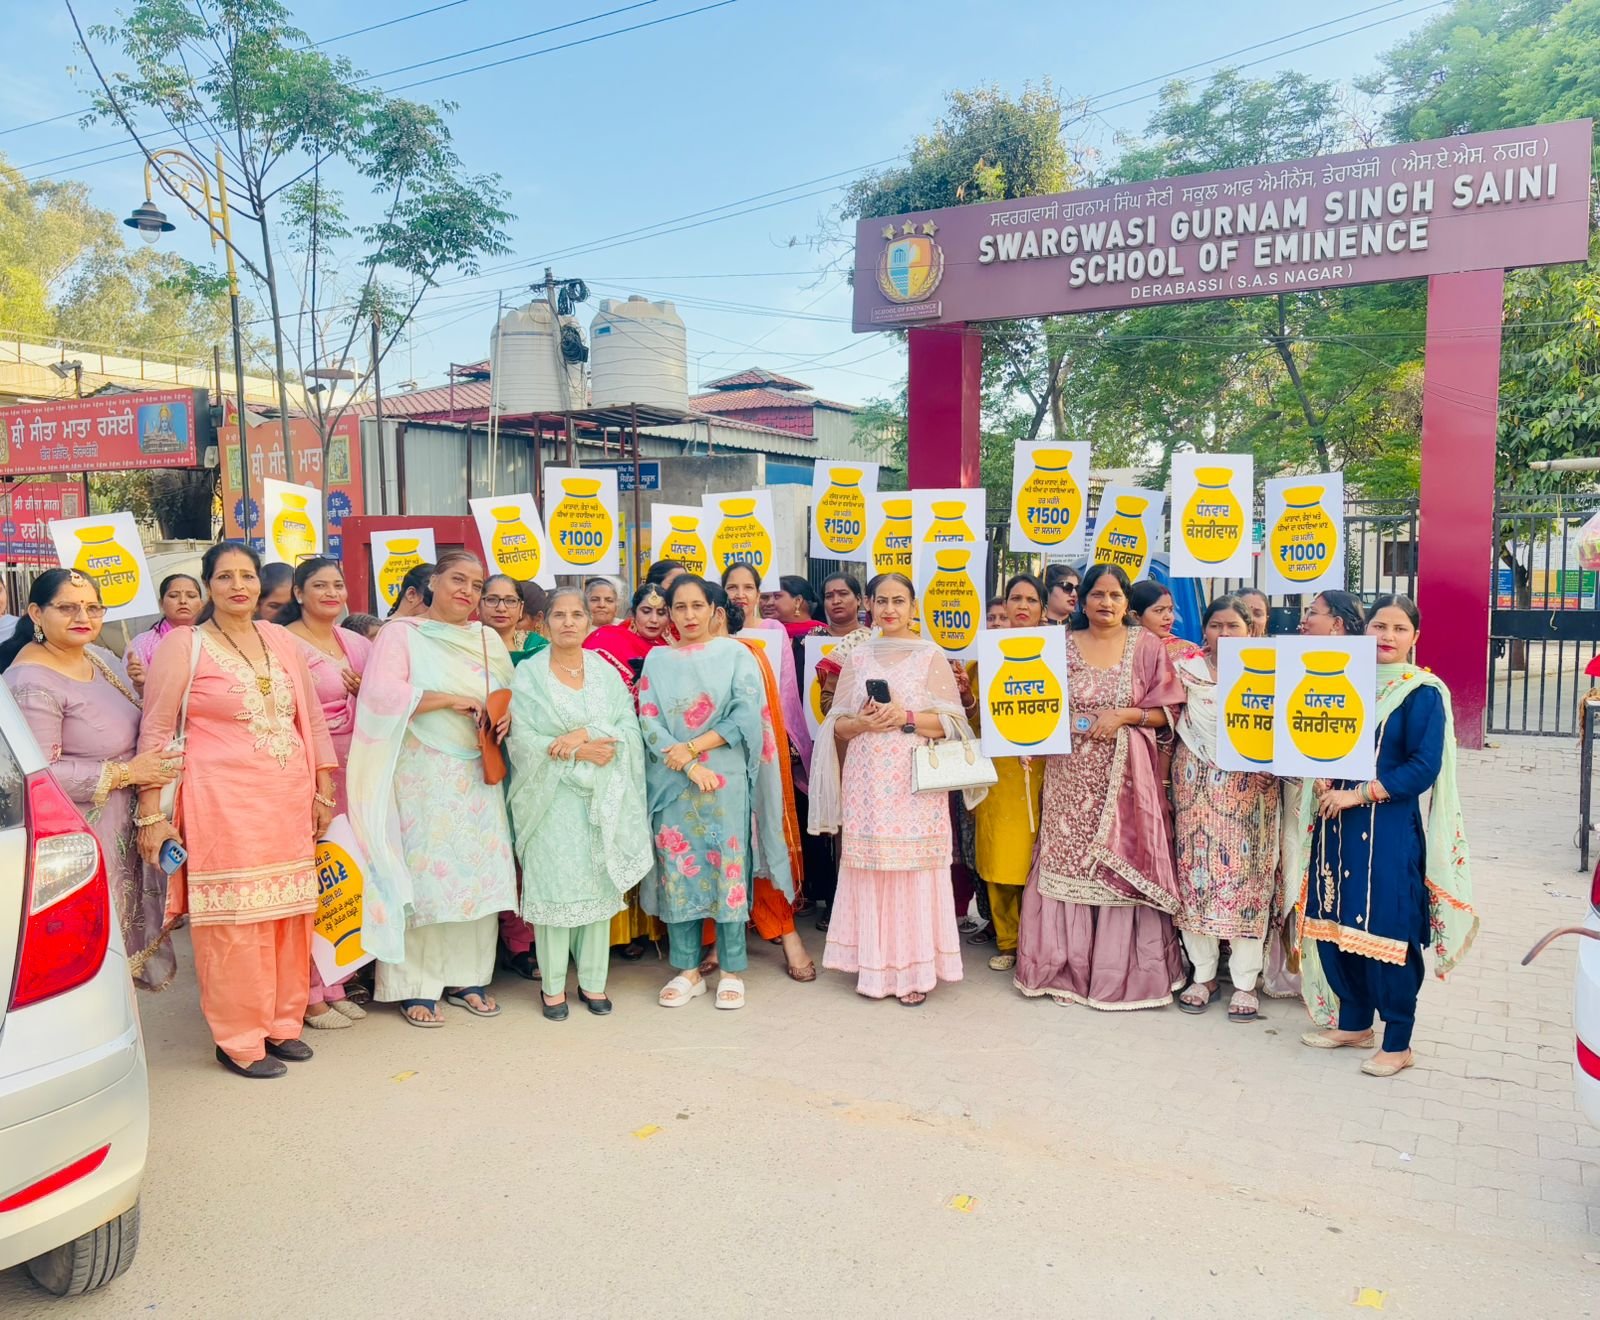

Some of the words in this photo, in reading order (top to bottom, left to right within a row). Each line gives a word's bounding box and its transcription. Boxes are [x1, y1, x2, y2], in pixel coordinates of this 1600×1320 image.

[990, 201, 1060, 227] ਸਵਰਗਵਾਸੀ
[1062, 199, 1110, 221] ਗੁਰਨਾਮ
[1114, 193, 1142, 213] ਸਿੰਘ
[1146, 187, 1174, 208] ਸੈਣੀ
[1182, 183, 1218, 207] ਸਕੂਲ
[1322, 156, 1381, 185] ਡੇਰਾਬੱਸੀ
[979, 215, 1156, 265] SWARGWASI
[1171, 196, 1308, 242] GURNAM
[1324, 179, 1435, 224] SINGH
[1452, 163, 1558, 209] SAINI
[1069, 246, 1185, 289] SCHOOL
[1198, 240, 1239, 274] OF
[1254, 217, 1430, 269] EMINENCE
[1131, 278, 1224, 299] DERABASSI
[29, 416, 57, 442] ਸੀਤਾ
[61, 418, 91, 439] ਮਾਤਾ
[96, 407, 135, 436] ਰਸੋਈ
[1027, 507, 1070, 525] ₹1500
[1196, 499, 1229, 517] ਧੰਨਵਾਦ
[825, 518, 860, 535] ₹1500
[1186, 519, 1239, 539] ਕੇਜਰੀਵਾਲ
[501, 532, 527, 546] ਧੰਨਵਾਦ
[560, 530, 603, 547] ₹1000
[671, 539, 696, 555] ਧੰਨਵਾਦ
[885, 532, 912, 549] ਧੰਨਵਾ
[1109, 528, 1138, 549] ਧੰਨਵਾਦ
[87, 553, 122, 570] ਧੰਨਵਾਦ
[497, 547, 538, 564] ਕੇਜਰੀਵਾਲ
[875, 552, 893, 566] ਮਾਨ
[896, 552, 912, 566] ਸਰ
[1095, 547, 1112, 561] ਮਾਨ
[1112, 550, 1144, 568] ਸਰਕਾਰ
[1280, 543, 1325, 561] ₹1000
[933, 610, 970, 629] ₹1500
[1004, 676, 1044, 695] ਧੰਨਵਾਦ
[991, 701, 1014, 716] ਮਾਨ
[1017, 698, 1060, 714] ਸਰਕਾਰ
[1241, 688, 1275, 710] ਧੰਨਵਾ
[1304, 688, 1346, 709] ਧੰਨਵਾਦ
[1226, 713, 1250, 729] ਮਾਨ
[1253, 714, 1274, 731] ਸਰ
[1292, 710, 1358, 734] ਕੇਜਰੀਵਾਲ
[318, 860, 349, 895] ₹150
